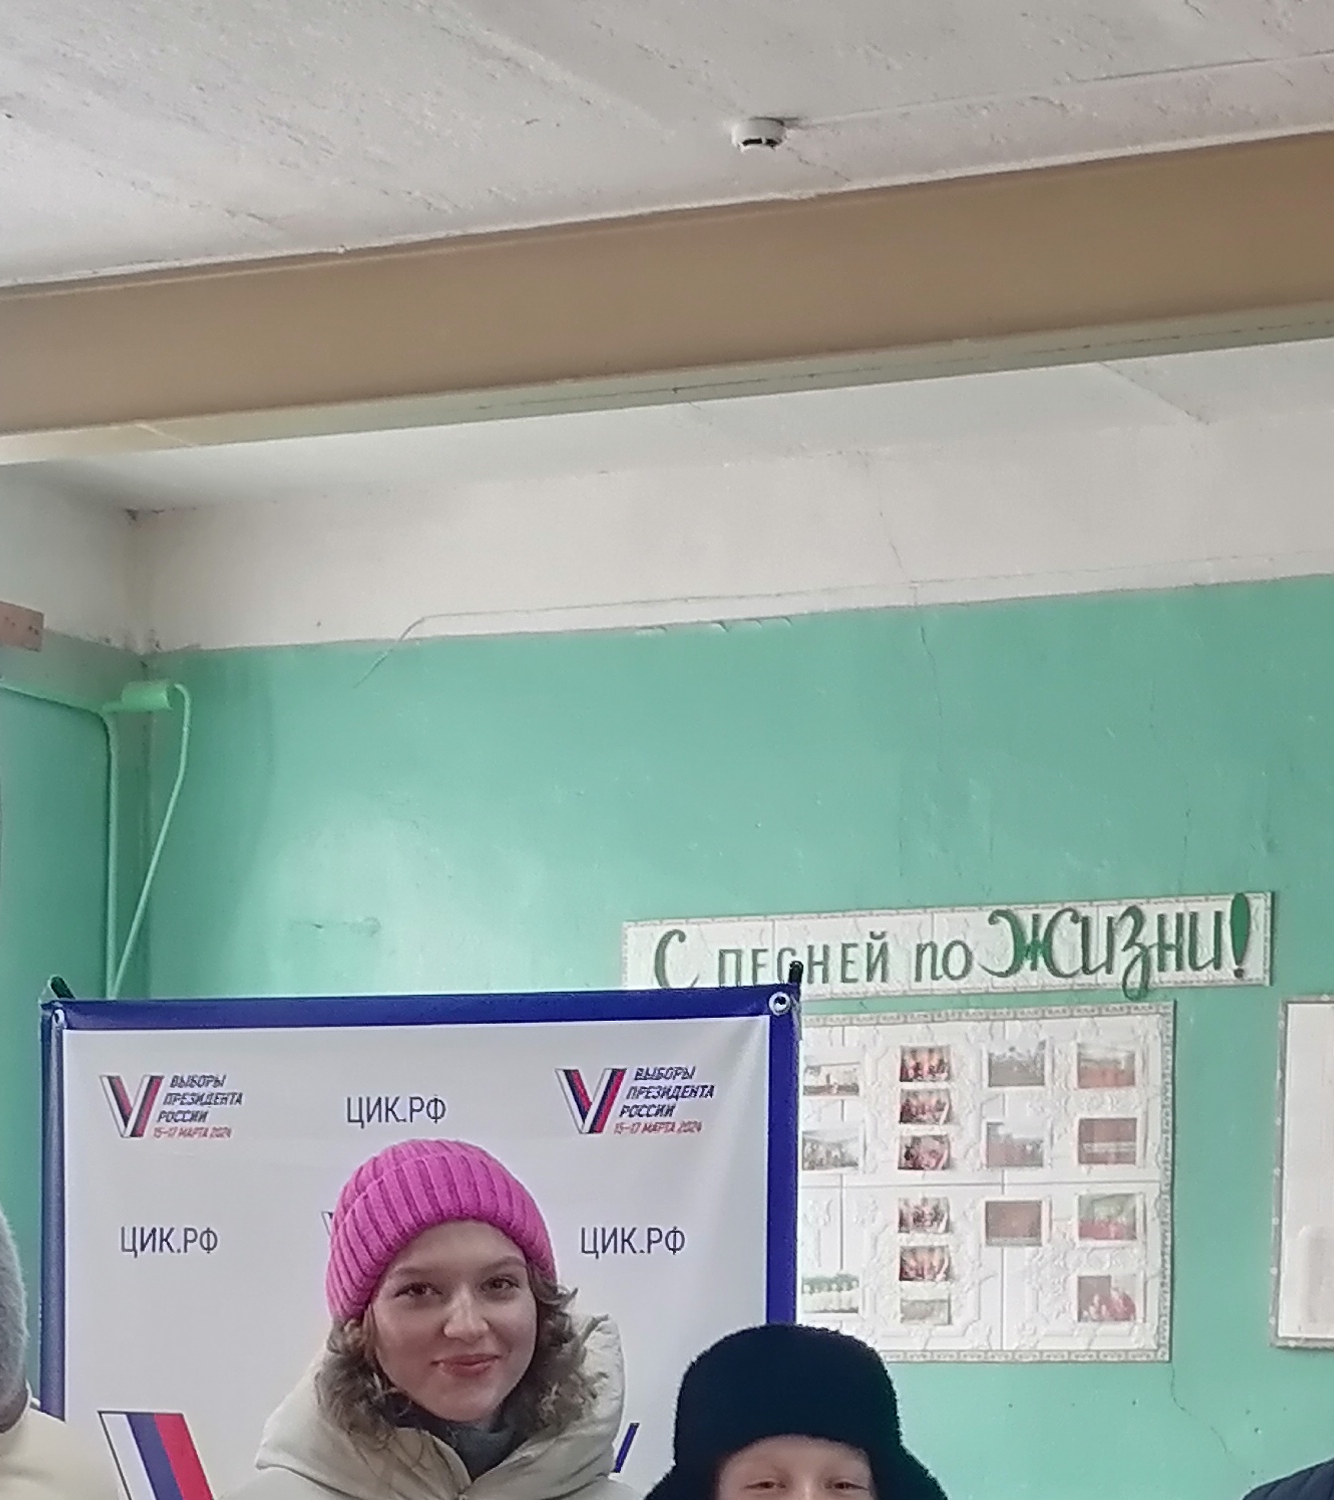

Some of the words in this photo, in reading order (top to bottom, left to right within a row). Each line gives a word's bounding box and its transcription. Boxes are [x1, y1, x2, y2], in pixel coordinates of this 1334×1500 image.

[654, 929, 699, 988] С
[169, 1074, 227, 1088] ВЫБОРЫ
[633, 1066, 696, 1081] ВЫБОРЫ
[162, 1092, 244, 1107] ПРЕЗИДЕНТА
[625, 1084, 715, 1101] ПРЕЗИДЕНТА
[156, 1109, 209, 1123] РОССИИ
[347, 1095, 446, 1128] ЦИК.РФ
[618, 1104, 677, 1118] РОССИИ
[641, 1121, 676, 1133] МАРТА
[120, 1226, 219, 1258] ЦИК.РФ
[580, 1225, 686, 1256] ЦИК.РФ
